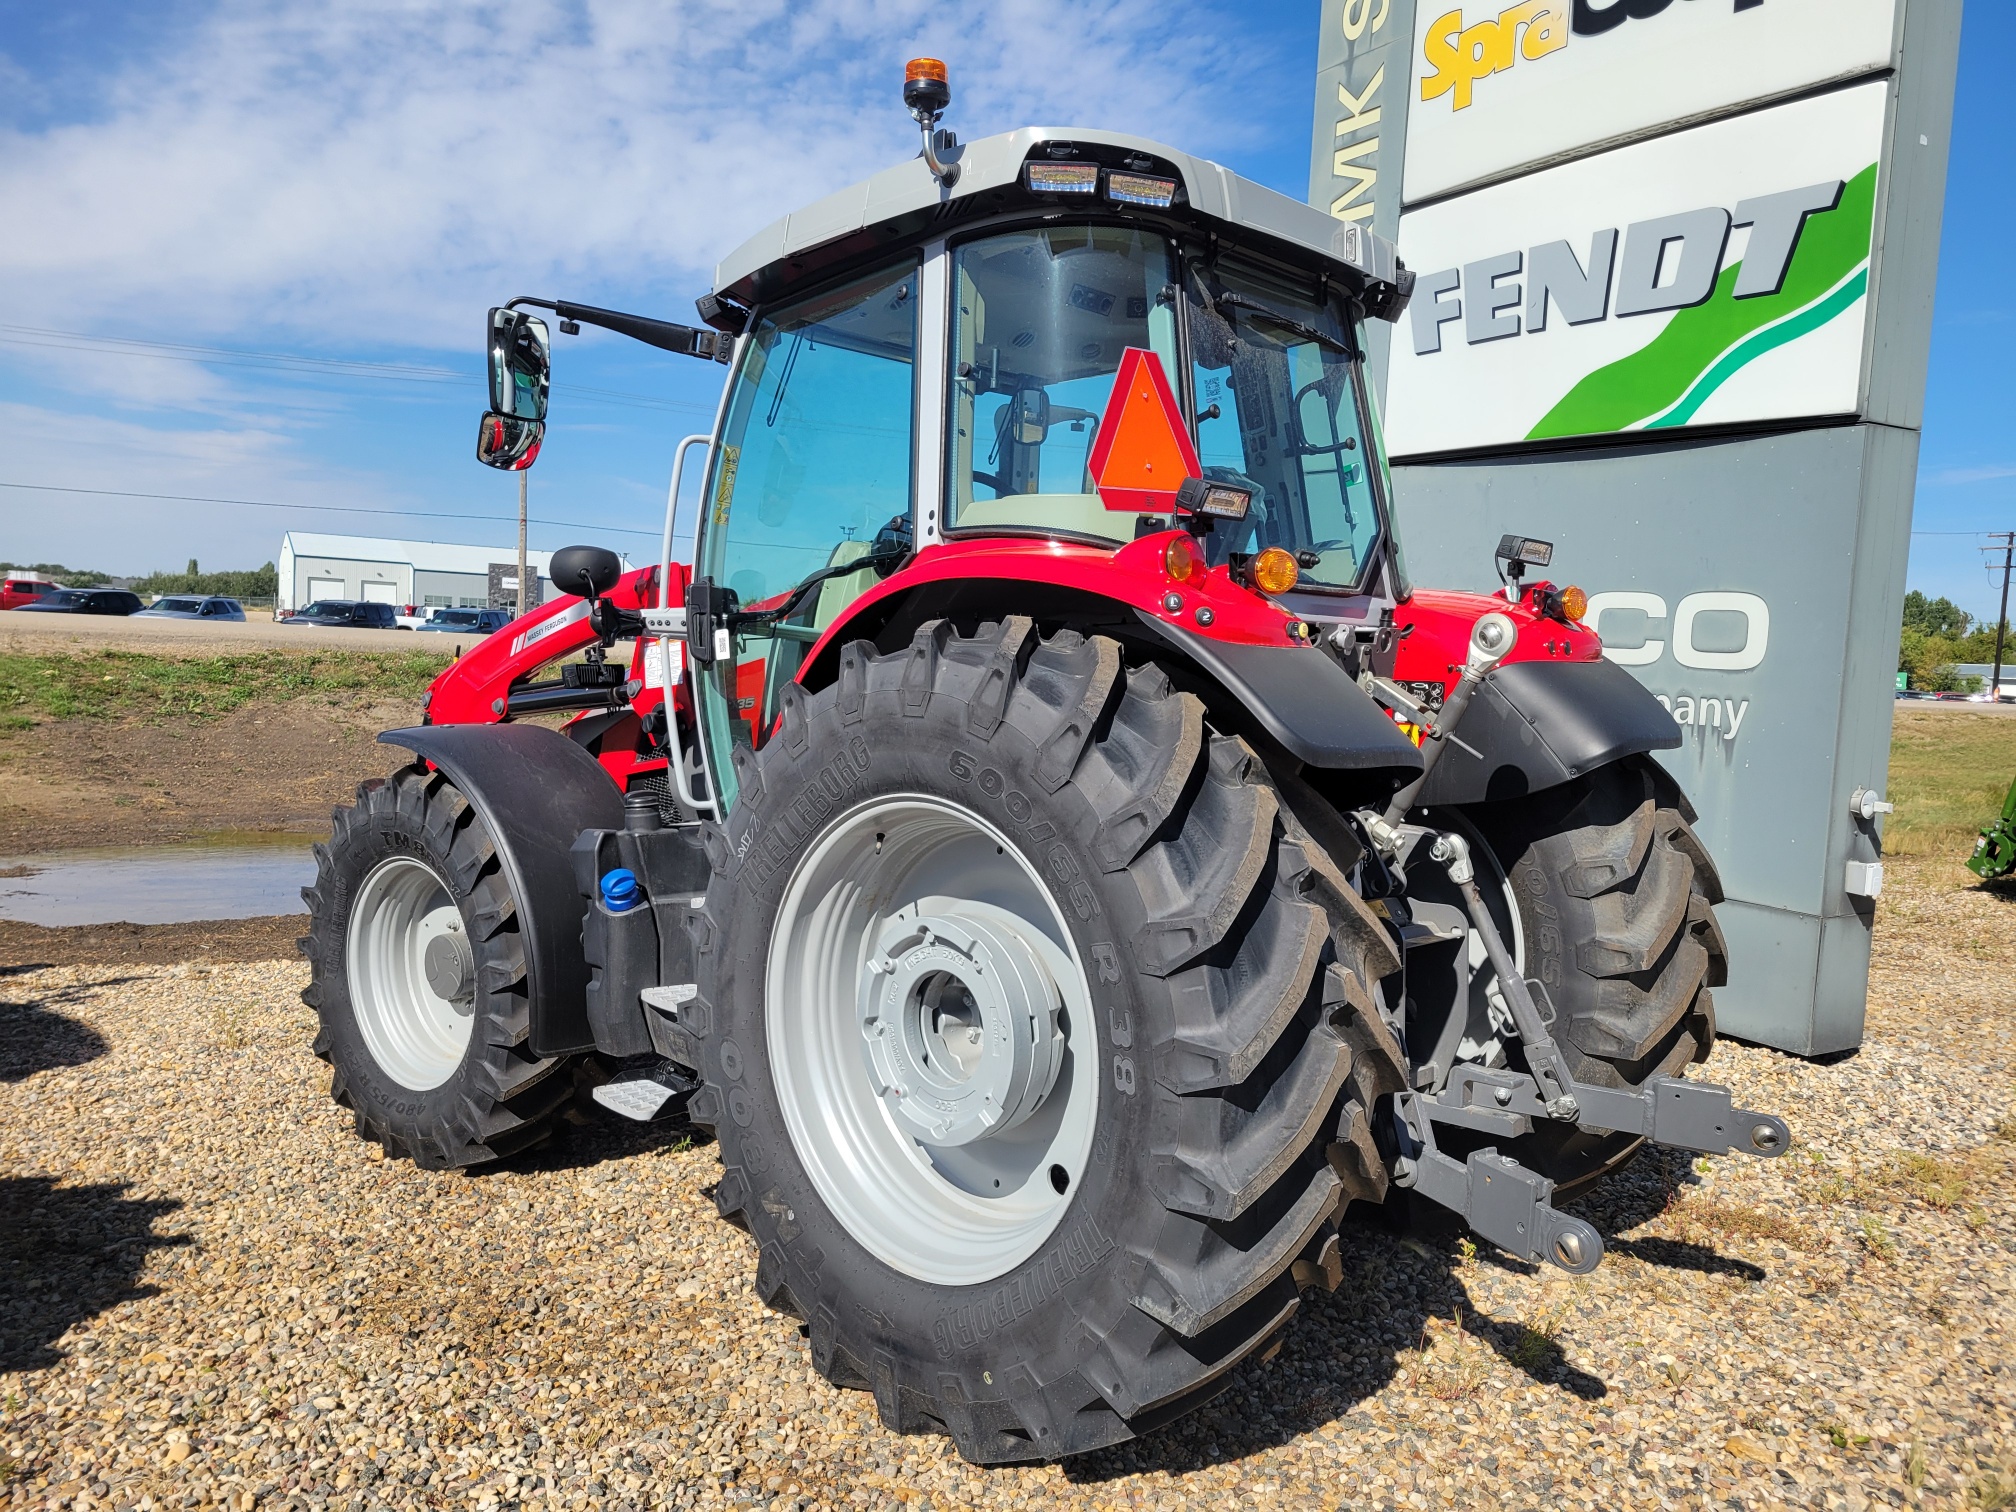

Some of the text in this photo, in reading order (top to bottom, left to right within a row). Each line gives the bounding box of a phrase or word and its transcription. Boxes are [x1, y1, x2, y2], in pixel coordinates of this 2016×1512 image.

[1329, 61, 1385, 234] MK
[1409, 179, 1847, 357] FENDT
[527, 614, 568, 642] MASSEY FERGUSON
[1582, 590, 1770, 671] CO
[734, 734, 873, 898] TRELLEBORG
[948, 749, 1102, 923] 600/65
[1091, 941, 1122, 985] R
[1108, 1006, 1136, 1097] 38
[931, 1212, 1116, 1361] TRELLEBORG
